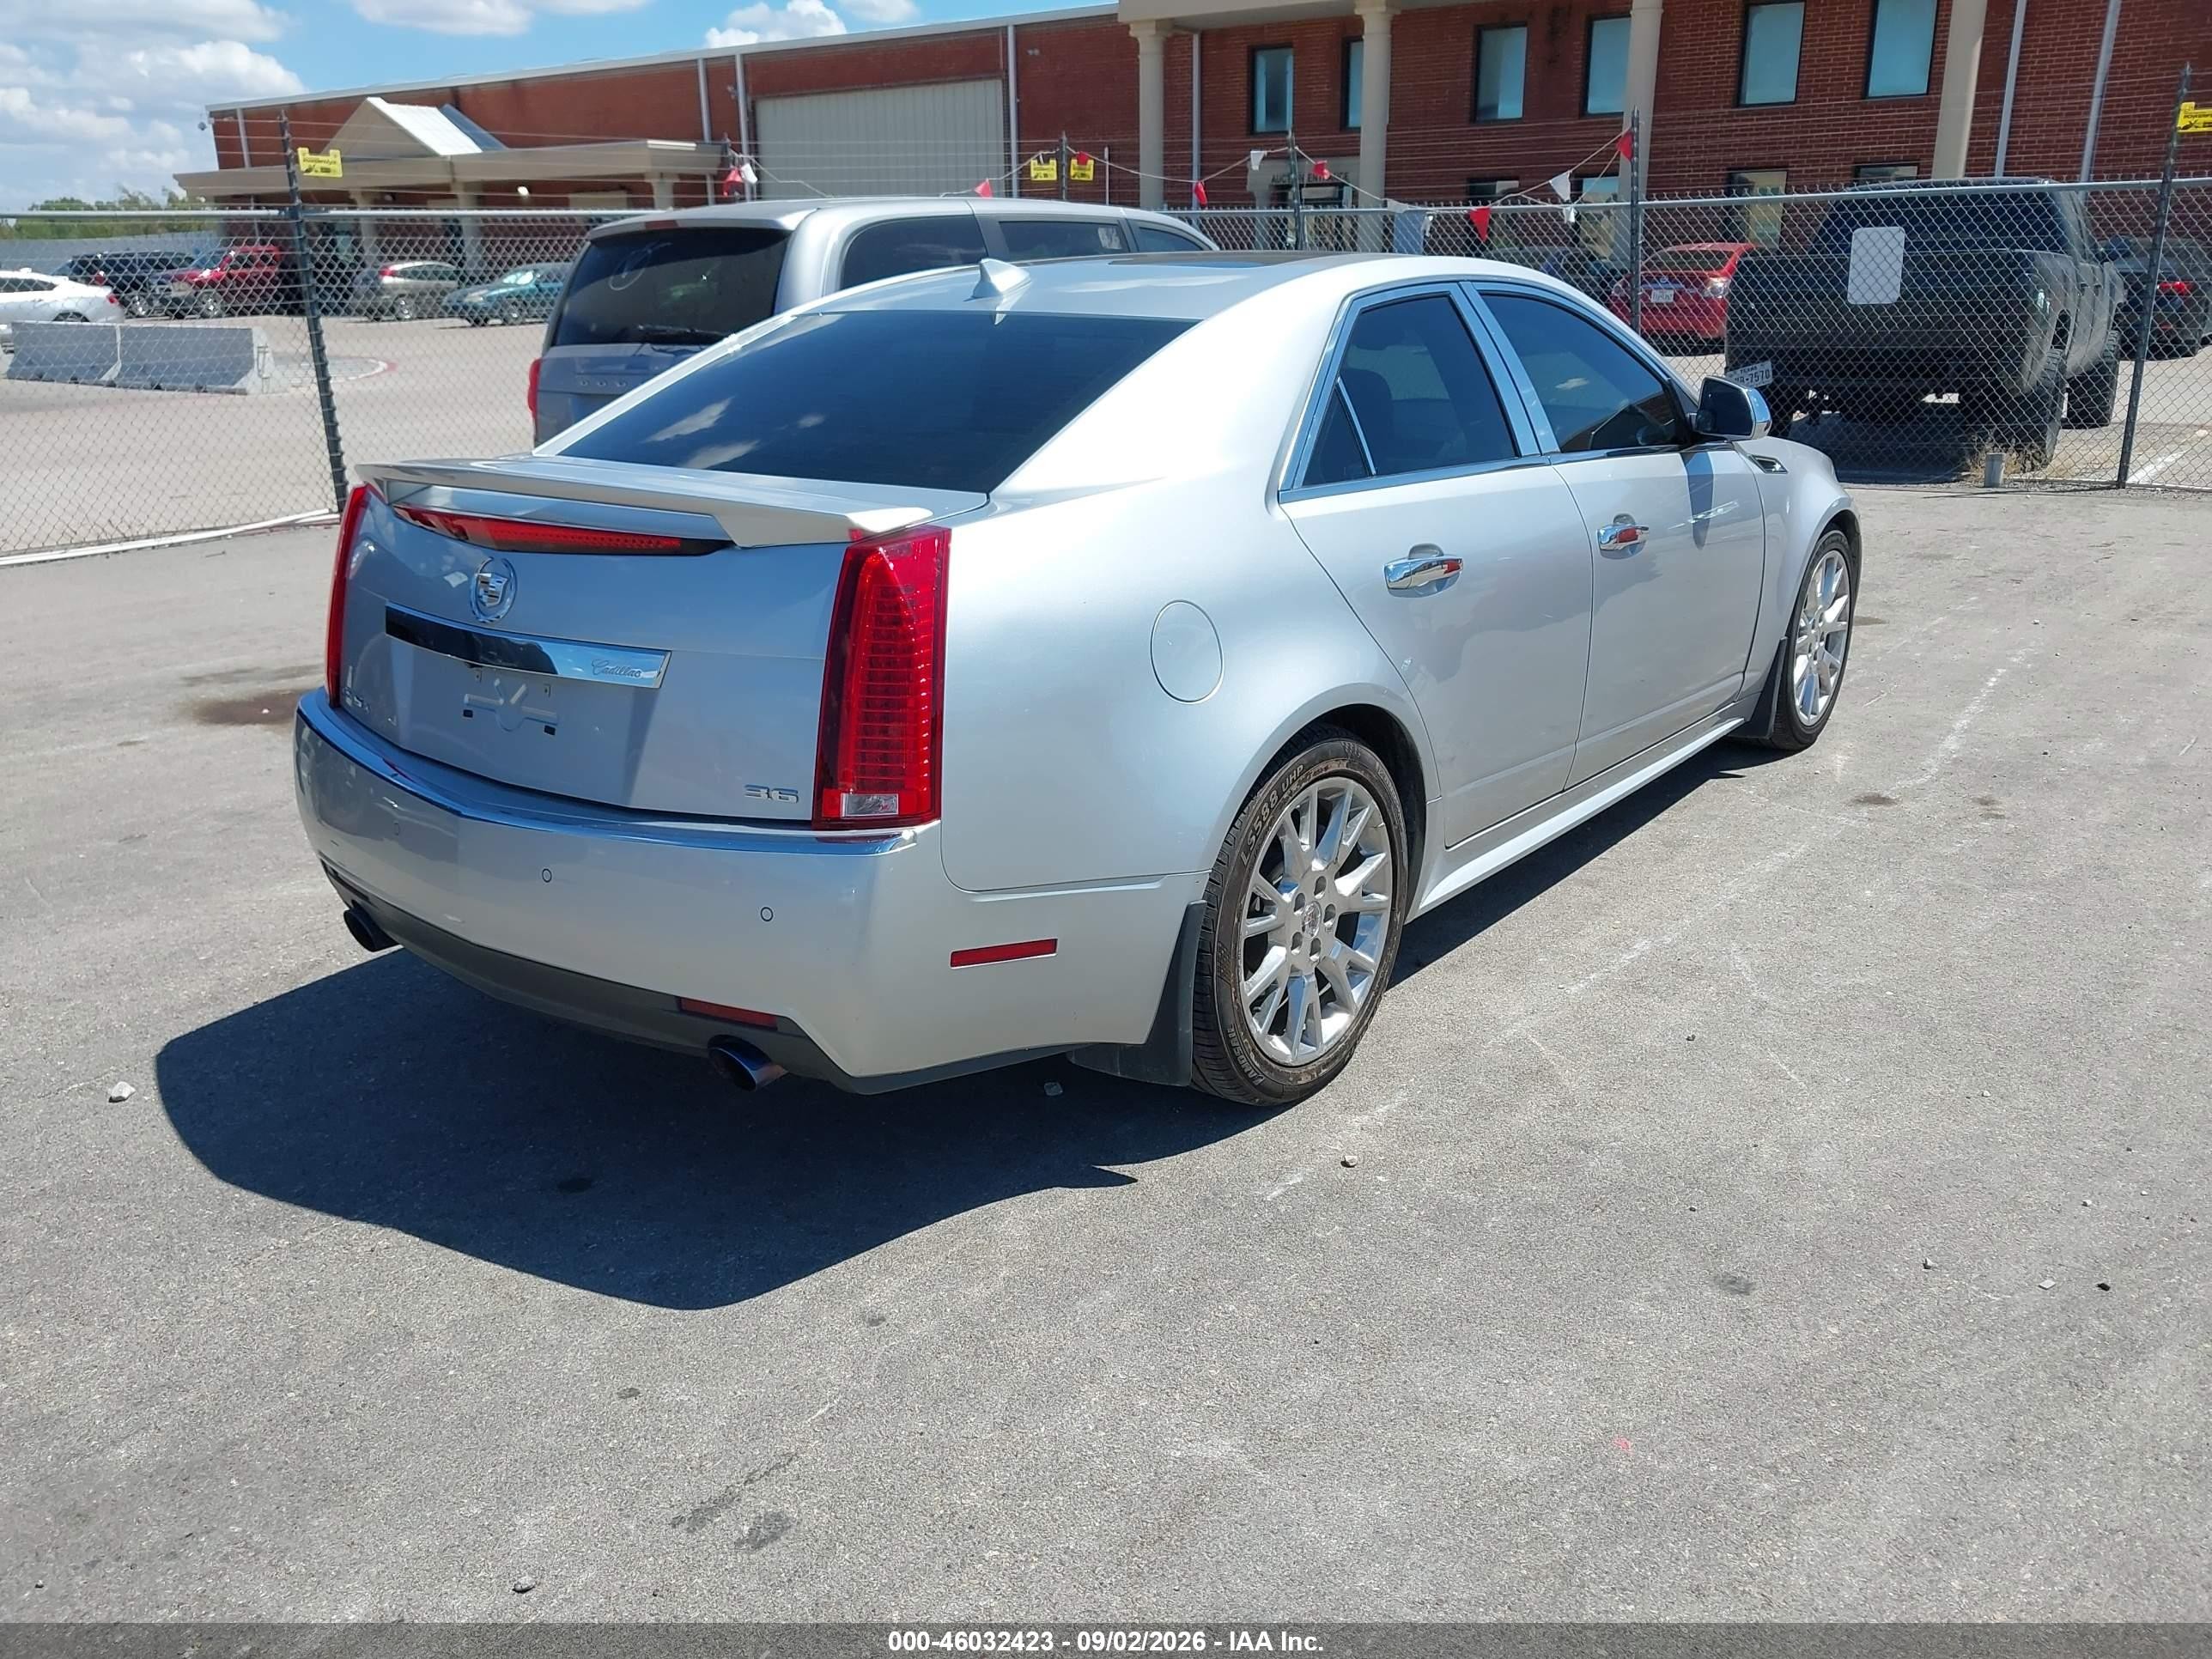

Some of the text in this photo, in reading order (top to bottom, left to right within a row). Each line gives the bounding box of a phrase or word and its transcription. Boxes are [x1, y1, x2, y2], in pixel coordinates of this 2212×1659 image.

[591, 659, 641, 678] Cadillac
[1240, 789, 1279, 866] LS588
[1280, 764, 1304, 793] UHP
